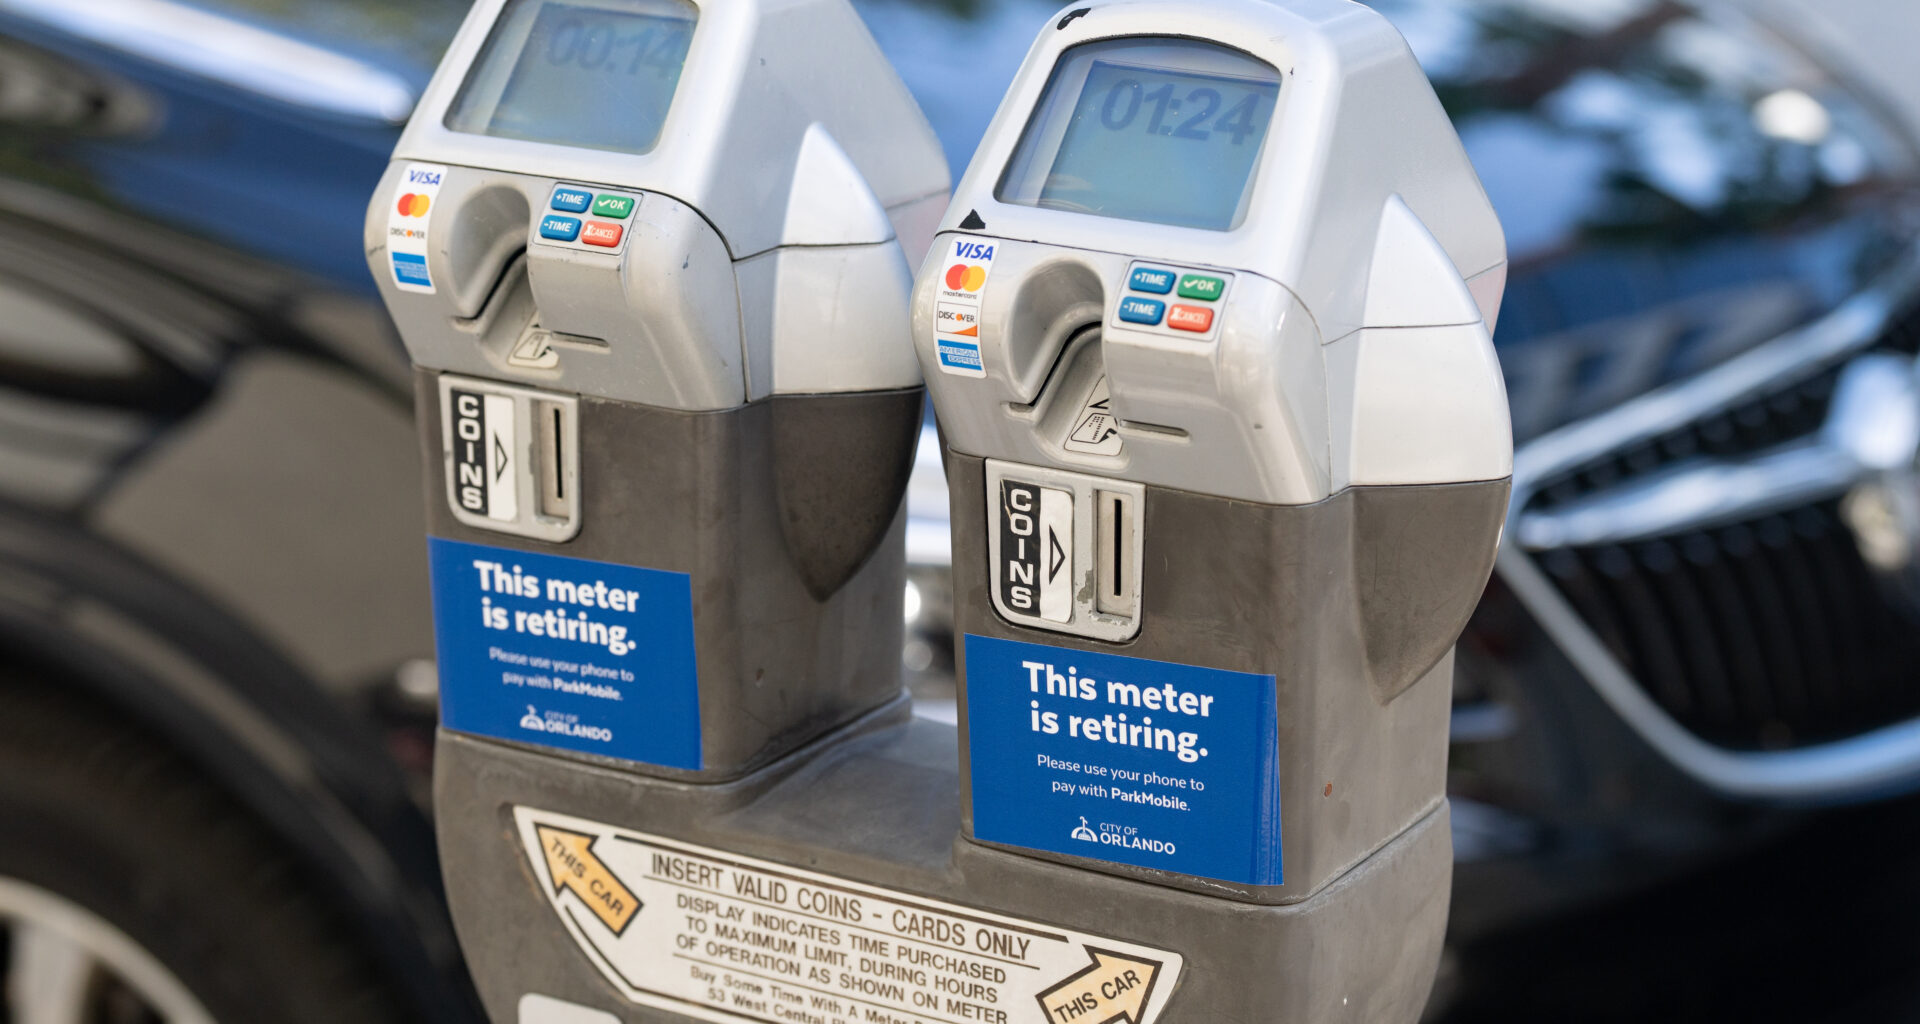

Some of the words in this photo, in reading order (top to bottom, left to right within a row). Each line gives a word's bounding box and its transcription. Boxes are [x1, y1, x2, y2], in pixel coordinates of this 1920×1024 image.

[1100, 78, 1260, 146] 01:24
[409, 170, 441, 185] VISA
[556, 193, 585, 205] +TIME
[610, 199, 626, 210] OK
[543, 221, 572, 232] -TIME
[955, 241, 994, 260] VISA
[1135, 272, 1167, 286] +TIME
[1197, 280, 1216, 292] OK
[1123, 302, 1156, 316] -TIME
[458, 395, 483, 510] COINS
[1009, 489, 1033, 609] COINS
[473, 560, 540, 598] This
[546, 579, 640, 613] meter
[482, 596, 509, 630] is
[515, 608, 636, 656] retiring.
[489, 646, 528, 666] Please
[529, 657, 550, 669] use
[552, 659, 579, 673] your
[581, 663, 619, 680] phone
[621, 669, 635, 682] to
[502, 672, 524, 687] pay
[526, 674, 552, 689] with
[553, 677, 623, 701] ParkMobile.
[1022, 660, 1097, 700] This
[1107, 683, 1214, 717] meter
[544, 710, 564, 721] CITY
[565, 714, 579, 723] OF
[545, 719, 612, 742] ORLANDO
[1031, 700, 1059, 735] is
[1069, 713, 1208, 763] retiring.
[1037, 754, 1080, 772] Please
[1084, 764, 1107, 776] use
[1110, 768, 1140, 781] your
[1143, 772, 1186, 789] phone
[1189, 778, 1205, 791] to
[1052, 781, 1076, 795] pay
[1079, 784, 1107, 798] with
[1111, 788, 1191, 811] ParkMobile.
[1099, 823, 1122, 834] CITY
[1124, 826, 1138, 835] OF
[1100, 833, 1175, 855] ORLANDO
[550, 837, 586, 879] THIS
[589, 879, 625, 916] CAR
[651, 853, 723, 889] INSERT
[733, 871, 788, 905] VALID
[798, 888, 862, 922] COINS
[892, 909, 966, 946] CARDS
[976, 928, 1031, 961] ONLY
[677, 893, 744, 922] DISPLAY
[753, 911, 840, 945] INDICATES
[848, 933, 889, 957] TIME
[897, 945, 1006, 984] PURCHASED
[686, 915, 707, 934] TO
[715, 923, 797, 954] MAXIMUM
[804, 944, 852, 971] LIMIT,
[860, 957, 927, 987] DURING
[935, 975, 998, 1004] HOURS
[676, 934, 698, 950] OF
[706, 941, 800, 977] OPERATION
[808, 966, 831, 984] AS
[840, 973, 904, 1002] SHOWN
[912, 991, 938, 1010] ON
[947, 999, 1007, 1024] METER
[690, 965, 716, 984] Buy
[724, 974, 763, 995] Some
[770, 985, 803, 1004] Time
[810, 995, 842, 1014] With
[848, 1005, 858, 1018] A
[1053, 992, 1098, 1024] THIS
[1101, 969, 1142, 1000] CAR
[708, 987, 725, 1002] 53
[732, 993, 767, 1013] West
